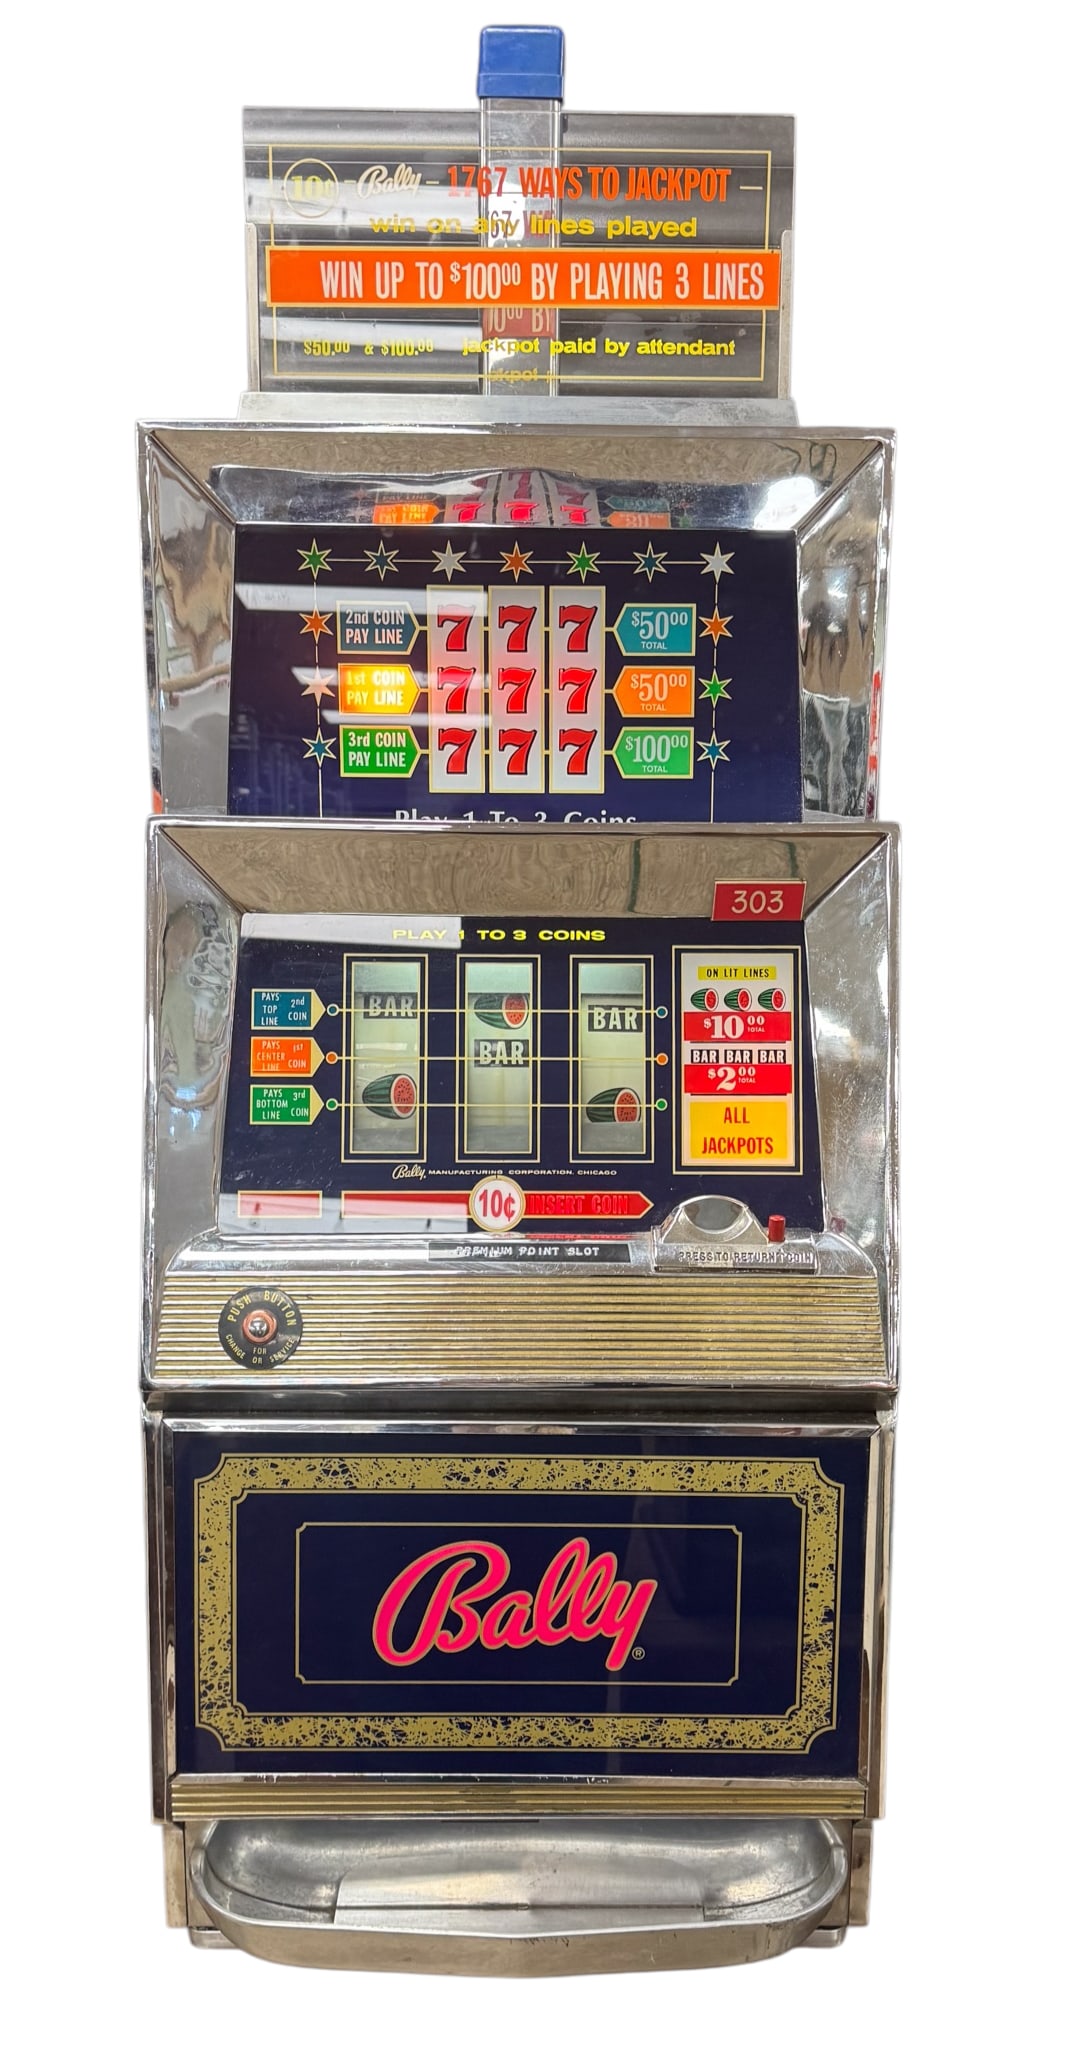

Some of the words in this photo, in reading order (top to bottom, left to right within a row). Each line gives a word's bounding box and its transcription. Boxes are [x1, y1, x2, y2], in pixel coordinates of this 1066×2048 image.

[357, 163, 422, 199] Bally
[448, 165, 507, 197] 1767
[519, 166, 582, 199] WAYS
[588, 167, 619, 200] TO
[625, 168, 731, 201] JACKPOT
[369, 213, 416, 233] win
[427, 217, 461, 233] on
[472, 217, 520, 236] any
[530, 216, 594, 234] lines
[607, 216, 697, 240] played
[320, 261, 363, 298] WIN
[375, 262, 404, 299] UP
[415, 262, 443, 300] TO
[531, 262, 558, 300] BY
[570, 262, 663, 300] PLAYING
[675, 262, 690, 299] 3
[703, 262, 764, 300] LINES
[304, 339, 350, 356] $50.00
[364, 343, 374, 355] &
[381, 339, 433, 357] $100.00
[462, 337, 539, 356] jackpot
[551, 338, 596, 356] paid
[605, 338, 629, 357] by
[637, 338, 735, 356] attendant
[345, 609, 368, 625] 2nd
[373, 609, 405, 625] COIN
[437, 604, 476, 652] 7
[498, 605, 537, 652] 7
[559, 605, 598, 652] 7
[345, 628, 369, 644] PAY
[375, 629, 403, 645] LINE
[641, 641, 667, 650] TOTAL
[347, 671, 366, 685] 1st
[373, 671, 405, 685] COIN
[437, 666, 476, 713] 7
[498, 667, 537, 714] 7
[558, 667, 597, 714] 7
[347, 691, 368, 705] PAY
[374, 691, 404, 706] LINE
[348, 732, 370, 747] 3rd
[375, 732, 406, 747] COIN
[438, 728, 477, 774] 7
[499, 728, 537, 775] 7
[559, 728, 598, 775] 7
[348, 752, 370, 766] PAY
[376, 752, 406, 767] LINE
[642, 765, 668, 773] TOTAL
[732, 890, 784, 914] 303
[392, 930, 447, 939] PLAY
[458, 930, 464, 940] 1
[477, 930, 505, 940] TO
[513, 930, 526, 940] 3
[538, 930, 605, 941] COINS
[706, 968, 718, 978] ON
[724, 968, 738, 977] LIT
[744, 968, 769, 978] LINES
[261, 992, 279, 1001] PAYS
[291, 996, 305, 1008] 2nd
[263, 1005, 278, 1014] TOP
[288, 1012, 307, 1021] COIN
[369, 995, 416, 1017] BAR
[593, 1006, 638, 1030] BAR
[261, 1017, 278, 1026] LINE
[262, 1040, 280, 1049] PAYS
[256, 1052, 285, 1061] CENTER
[478, 1041, 525, 1065] BAR
[693, 1050, 717, 1063] BAR
[727, 1050, 750, 1063] BAR
[760, 1050, 784, 1063] BAR
[262, 1063, 280, 1072] LINE
[288, 1059, 306, 1068] COIN
[263, 1089, 282, 1098] PAYS
[293, 1090, 306, 1101] 3rd
[256, 1100, 288, 1109] BOTTOM
[262, 1111, 280, 1120] LINE
[291, 1108, 309, 1117] COIN
[724, 1107, 750, 1124] ALL
[702, 1137, 774, 1154] JACKPOTS
[479, 1189, 516, 1221] 10¢
[530, 1195, 585, 1214] INSERT
[591, 1195, 628, 1215] COIN
[455, 1246, 513, 1257] PREMIUM
[518, 1246, 559, 1257] POINT
[567, 1247, 600, 1256] SLOT
[679, 1251, 712, 1262] PRESS
[716, 1252, 729, 1262] TO
[734, 1252, 775, 1263] RETURN
[787, 1252, 813, 1263] COIN
[227, 1294, 252, 1322] PUSH
[263, 1290, 297, 1326] BUTTON
[225, 1334, 246, 1359] CHANGE
[269, 1338, 295, 1363] SERVICE
[253, 1347, 267, 1355] FOR
[372, 1537, 658, 1671] Bally
